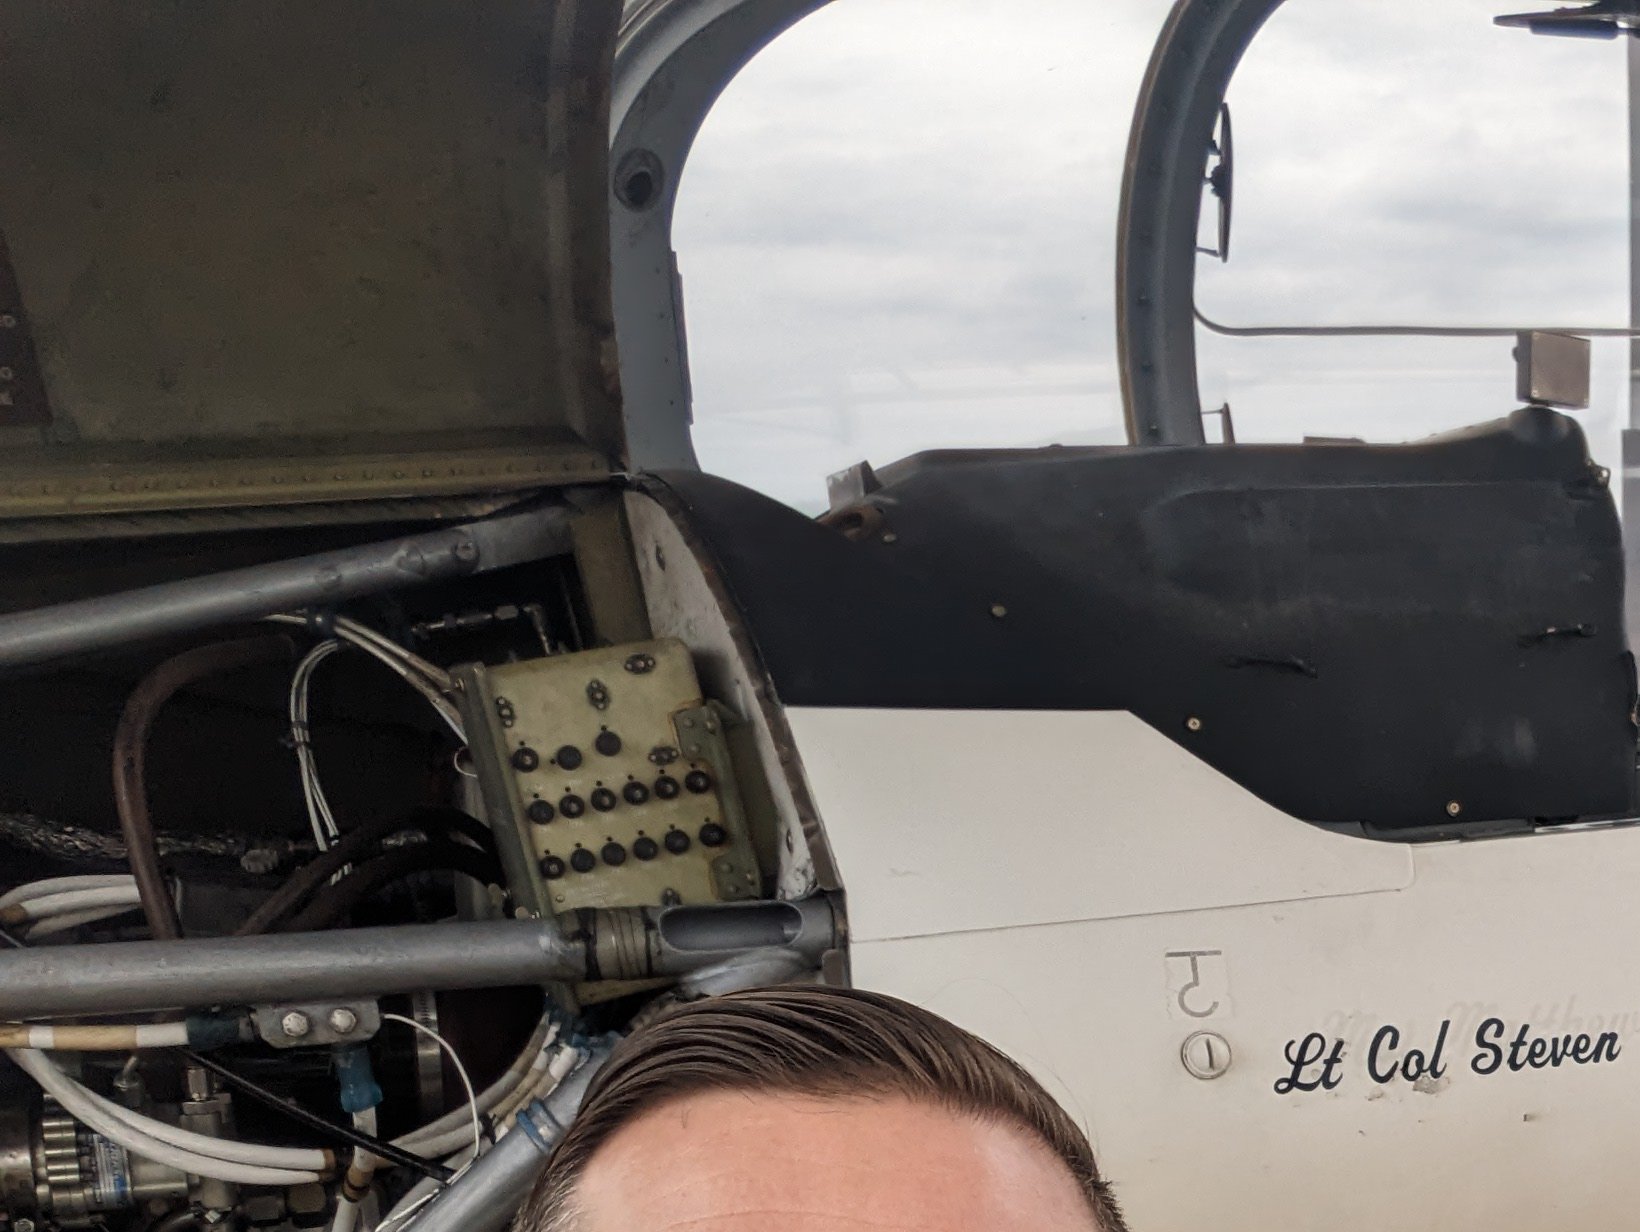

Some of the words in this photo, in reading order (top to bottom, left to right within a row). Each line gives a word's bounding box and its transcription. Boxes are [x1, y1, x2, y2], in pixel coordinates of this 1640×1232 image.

[1274, 1033, 1344, 1094] Lt
[1368, 1019, 1451, 1084] Col
[1471, 1017, 1622, 1075] Steven
